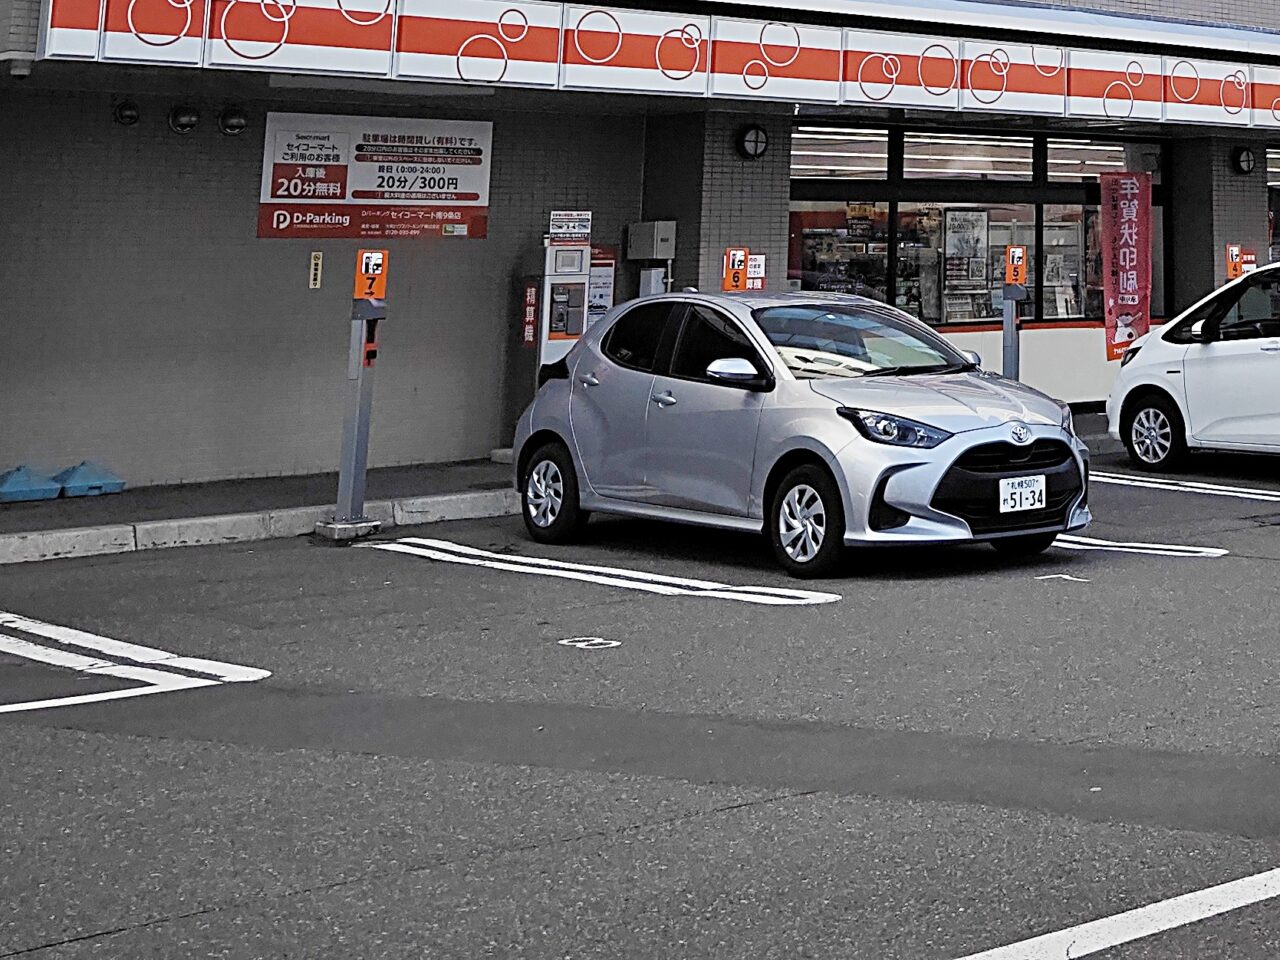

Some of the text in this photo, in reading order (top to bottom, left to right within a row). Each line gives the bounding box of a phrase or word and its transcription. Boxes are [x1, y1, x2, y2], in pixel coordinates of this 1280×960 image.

[286, 142, 338, 152] セイコーマート
[282, 152, 340, 162] ご利用のお客様
[295, 167, 326, 178] 入庫後
[276, 178, 341, 196] 20分無料
[293, 212, 350, 226] D-Parking
[732, 271, 740, 283] 6
[1012, 266, 1019, 277] 5
[366, 277, 376, 290] 7
[1010, 489, 1043, 508] 51-34
